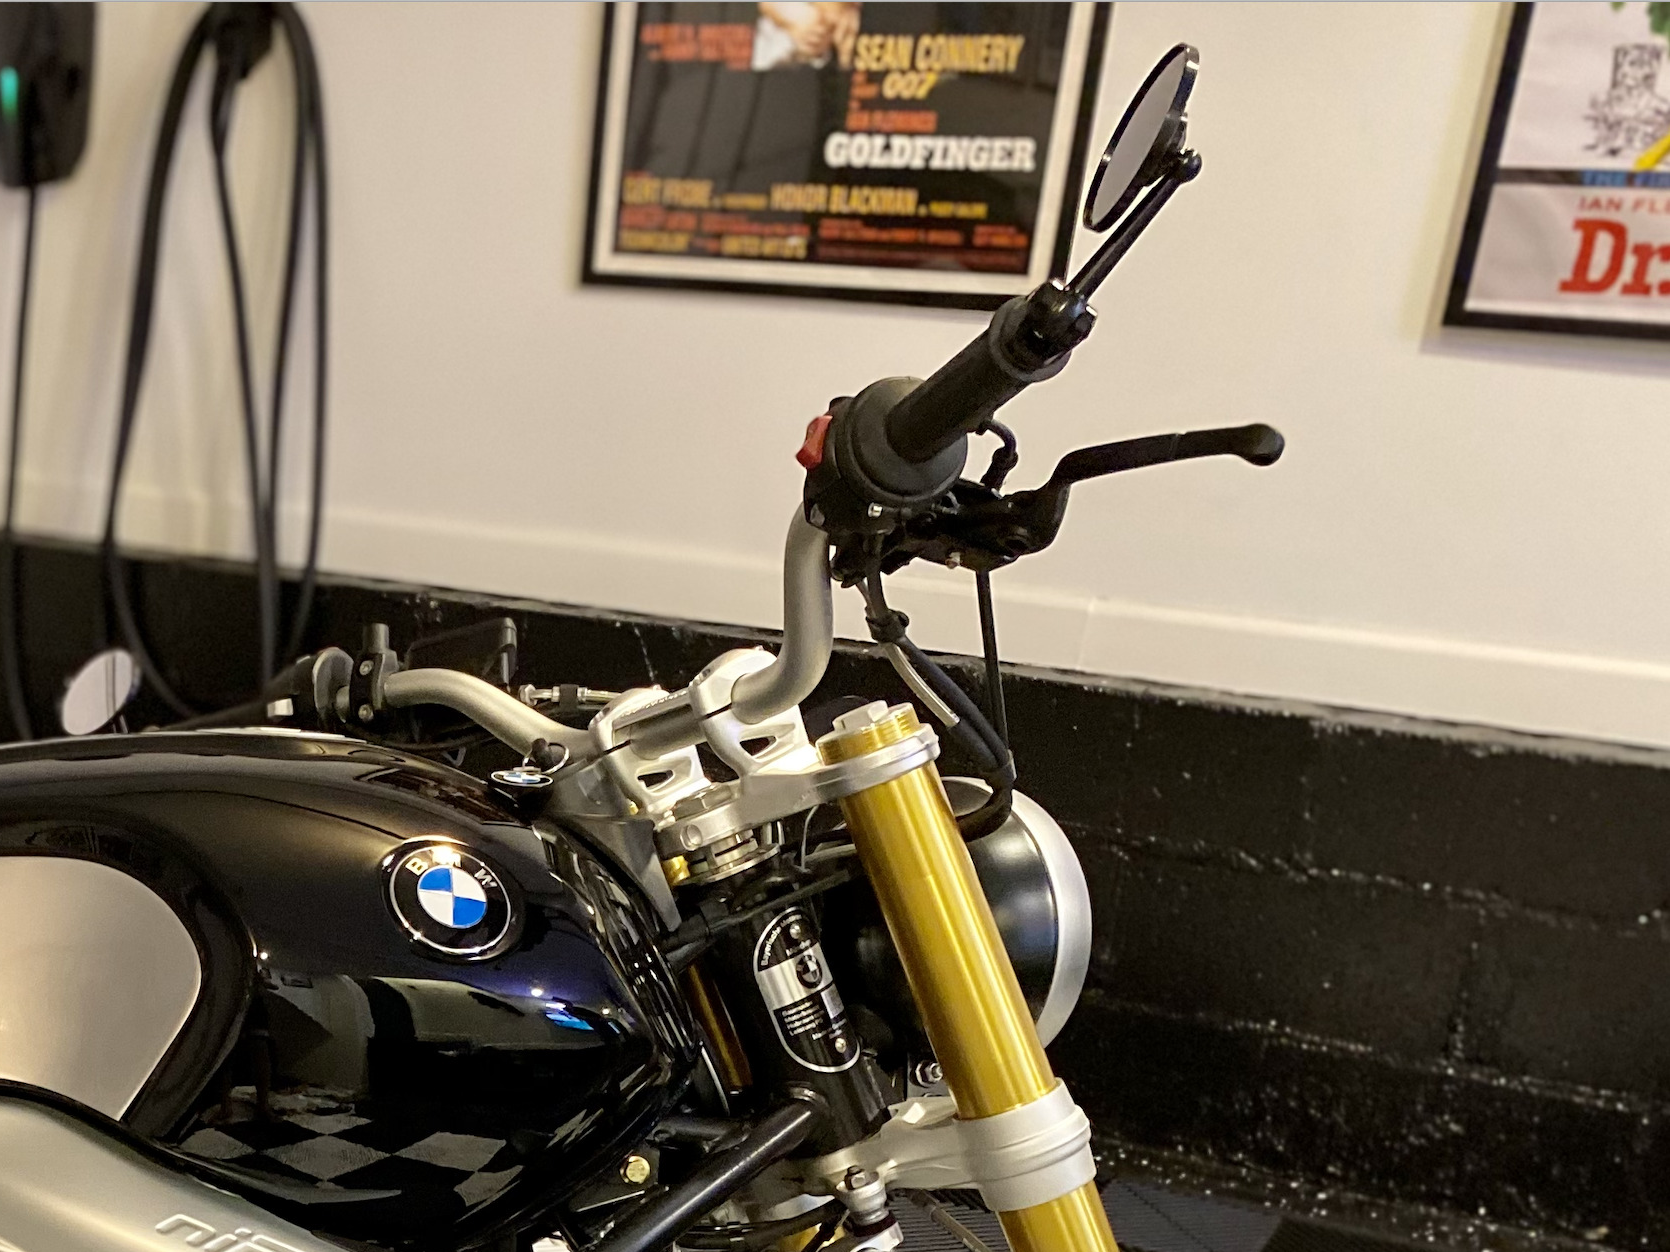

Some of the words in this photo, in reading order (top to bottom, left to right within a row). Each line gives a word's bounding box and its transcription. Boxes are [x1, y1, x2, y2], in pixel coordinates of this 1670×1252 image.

[855, 34, 915, 71] SEAN
[915, 34, 1025, 73] CONNERY
[882, 71, 939, 99] 007
[824, 132, 1036, 172] GOLDFINGER
[1578, 197, 1623, 212] IAN
[1631, 197, 1670, 216] FL
